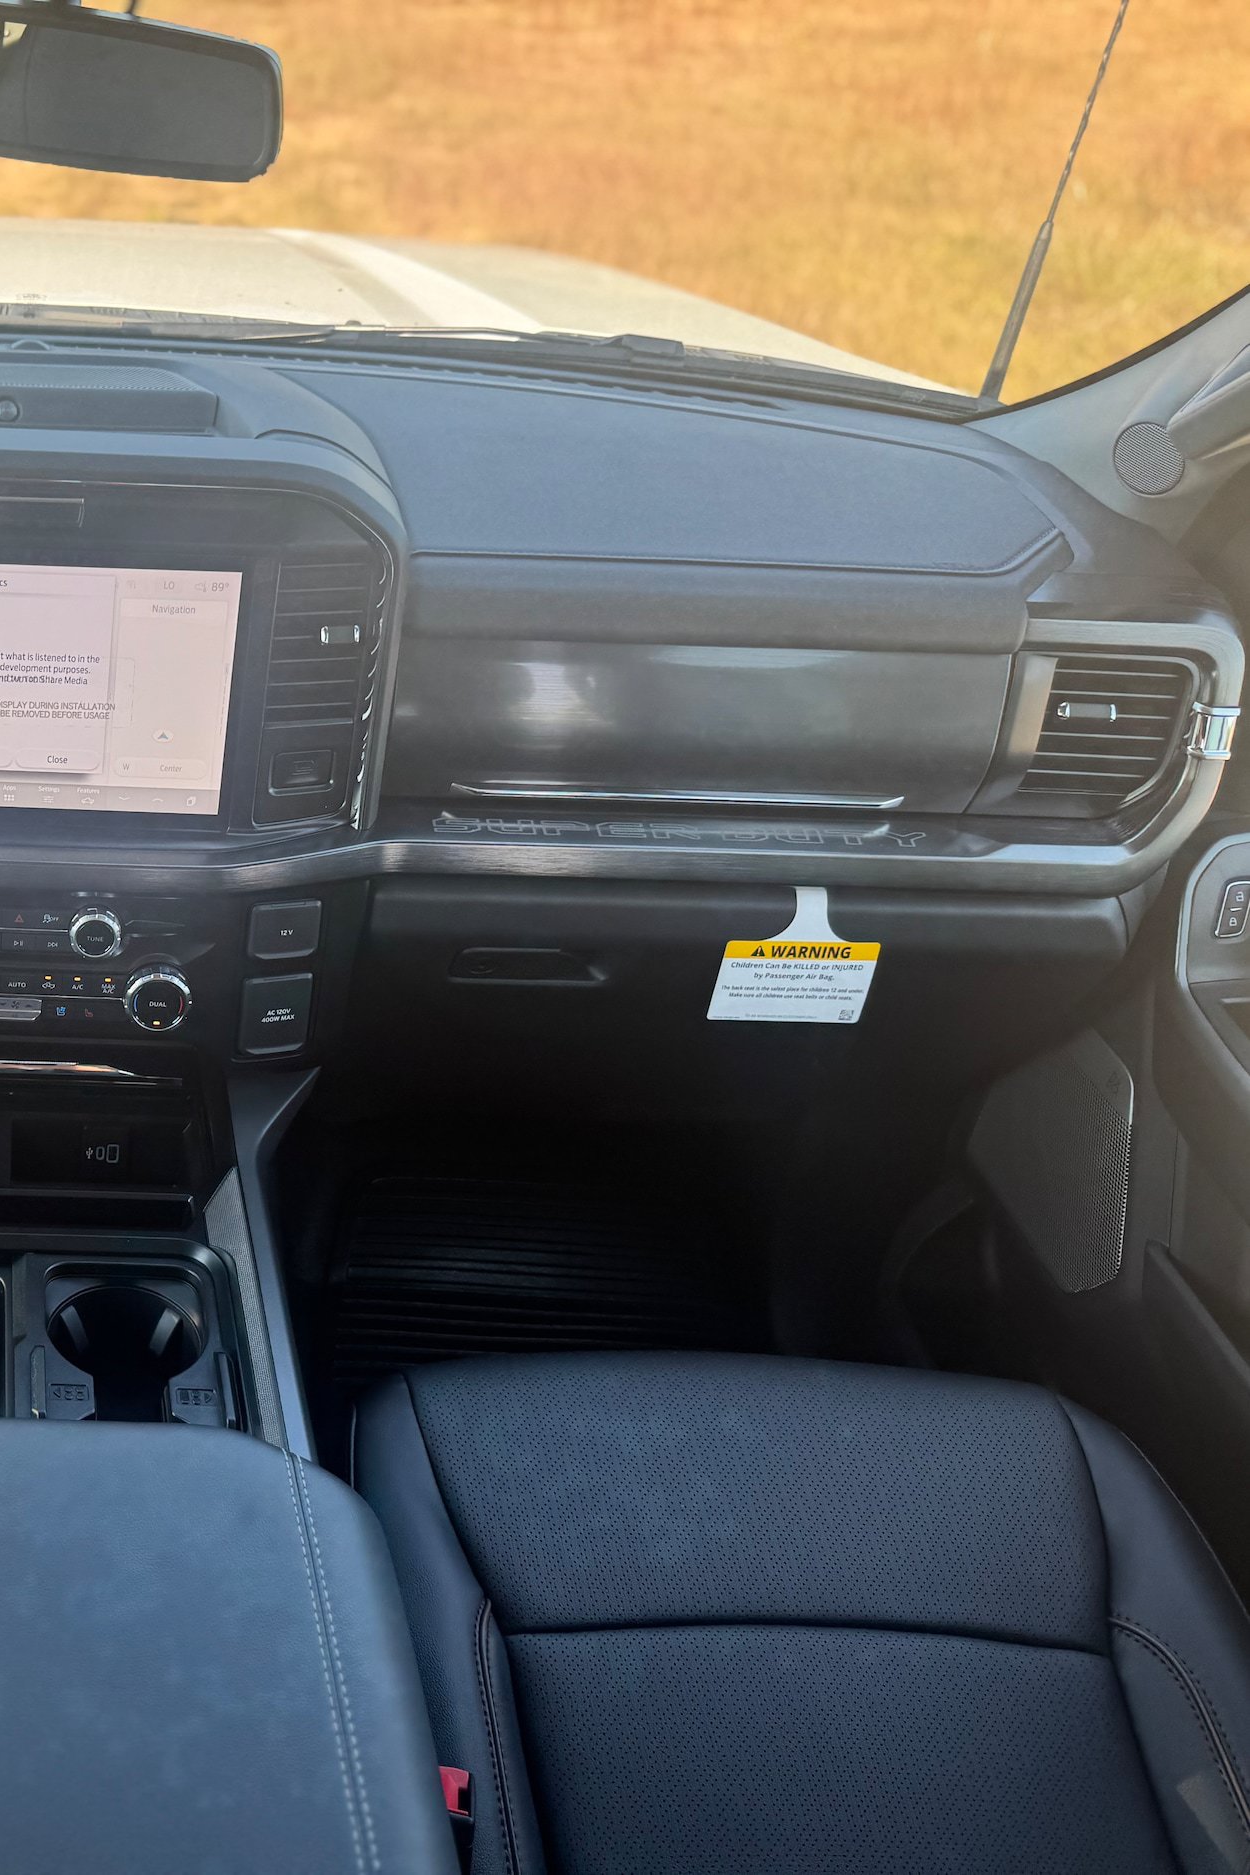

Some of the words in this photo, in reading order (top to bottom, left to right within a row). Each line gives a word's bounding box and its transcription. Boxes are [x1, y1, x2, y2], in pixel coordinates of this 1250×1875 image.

[211, 582, 229, 592] 89°
[152, 604, 196, 615] Navigation
[5, 652, 26, 661] what
[27, 653, 34, 661] is
[34, 653, 67, 663] listened
[68, 654, 76, 663] to
[77, 655, 85, 663] in
[86, 654, 100, 664] the
[0, 663, 52, 673] development
[53, 666, 91, 675] purposes.
[63, 677, 88, 685] Media
[28, 701, 59, 710] DURING
[60, 702, 116, 711] INSTALLATION
[11, 710, 51, 718] REMOVED
[51, 711, 82, 719] BEFORE
[83, 711, 110, 720] USAGE
[47, 755, 68, 764] Close
[159, 764, 183, 772] Center
[2, 784, 17, 792] Apps
[38, 785, 61, 793] Settings
[76, 787, 100, 795] Features
[432, 816, 701, 841] SUPER
[721, 826, 927, 849] DUTY
[770, 945, 852, 959] WARNING
[730, 961, 764, 970] Children
[793, 963, 820, 971] KILLED
[831, 963, 864, 972] INJURED
[754, 972, 763, 980] by
[764, 972, 804, 981] Passenger
[818, 973, 835, 982] Bag.
[261, 1015, 280, 1023] 400W
[280, 1014, 295, 1022] MAX
